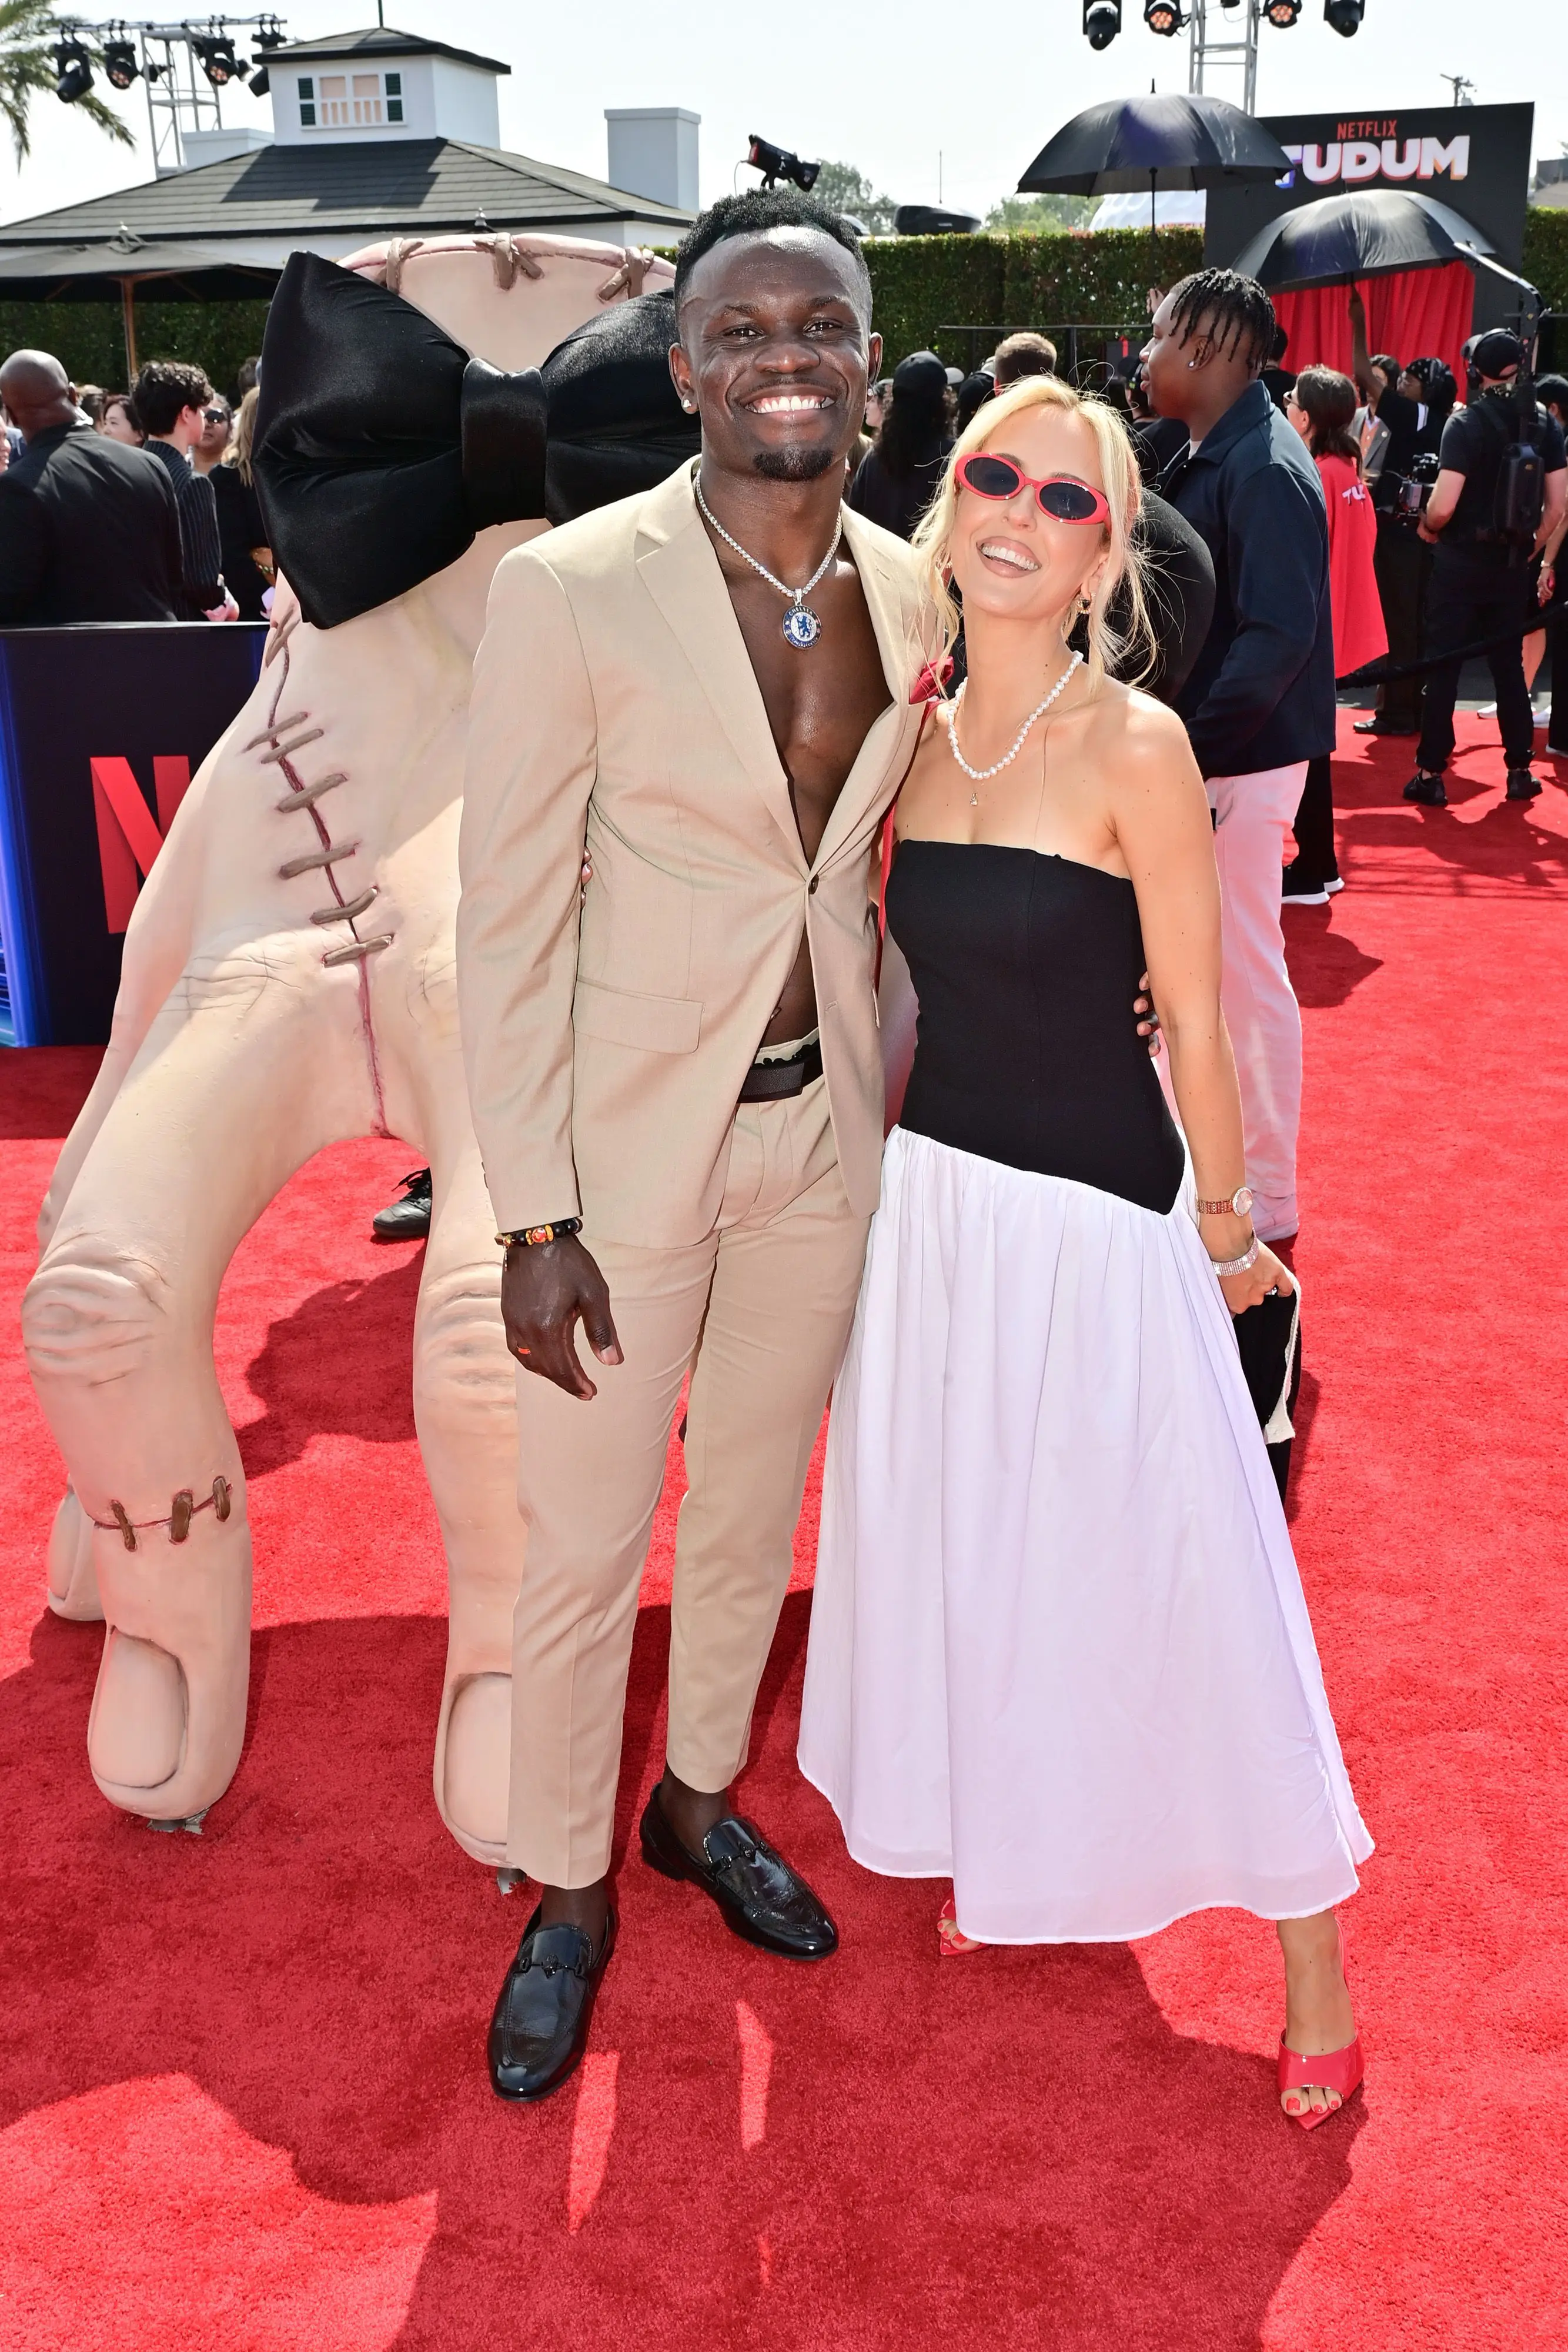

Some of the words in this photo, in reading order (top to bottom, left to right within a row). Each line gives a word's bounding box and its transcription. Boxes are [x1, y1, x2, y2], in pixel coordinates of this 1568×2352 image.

[1336, 119, 1397, 140] NETFLIX
[788, 606, 813, 616] CHELSEA
[90, 756, 191, 934] N
